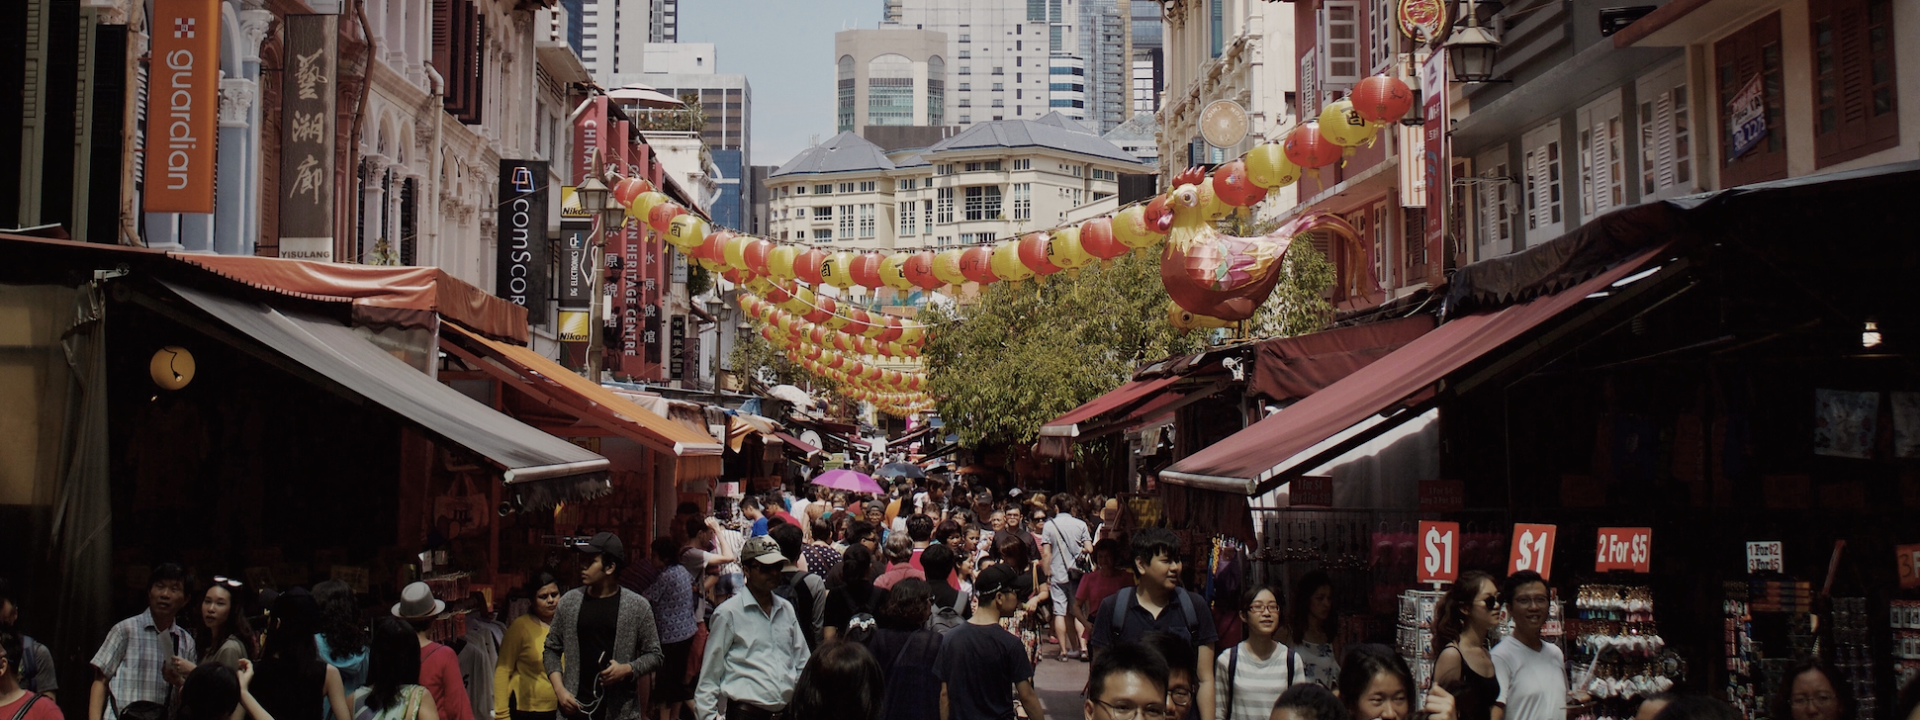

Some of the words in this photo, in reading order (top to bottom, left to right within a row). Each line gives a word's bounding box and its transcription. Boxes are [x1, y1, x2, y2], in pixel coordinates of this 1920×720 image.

[166, 48, 196, 191] guardian
[281, 250, 331, 259] YISULANG
[511, 198, 531, 304] comScor
[569, 247, 579, 285] ELECTRONICS
[625, 243, 638, 305] HERITAGE
[559, 332, 588, 340] Nikon
[624, 309, 637, 356] CENTRE
[1303, 480, 1313, 489] For
[1308, 493, 1318, 503] For
[1439, 496, 1449, 504] For
[1424, 526, 1452, 577] $1
[1516, 529, 1547, 573] $1
[1598, 534, 1607, 562] 2
[1609, 534, 1630, 563] For
[1631, 532, 1647, 567] $5
[1748, 544, 1753, 556] 1
[1754, 544, 1768, 556] For
[1768, 543, 1779, 555] $2
[1749, 559, 1755, 571] 3
[1755, 559, 1769, 571] For
[1769, 559, 1780, 571] $5
[1899, 553, 1912, 578] 3
